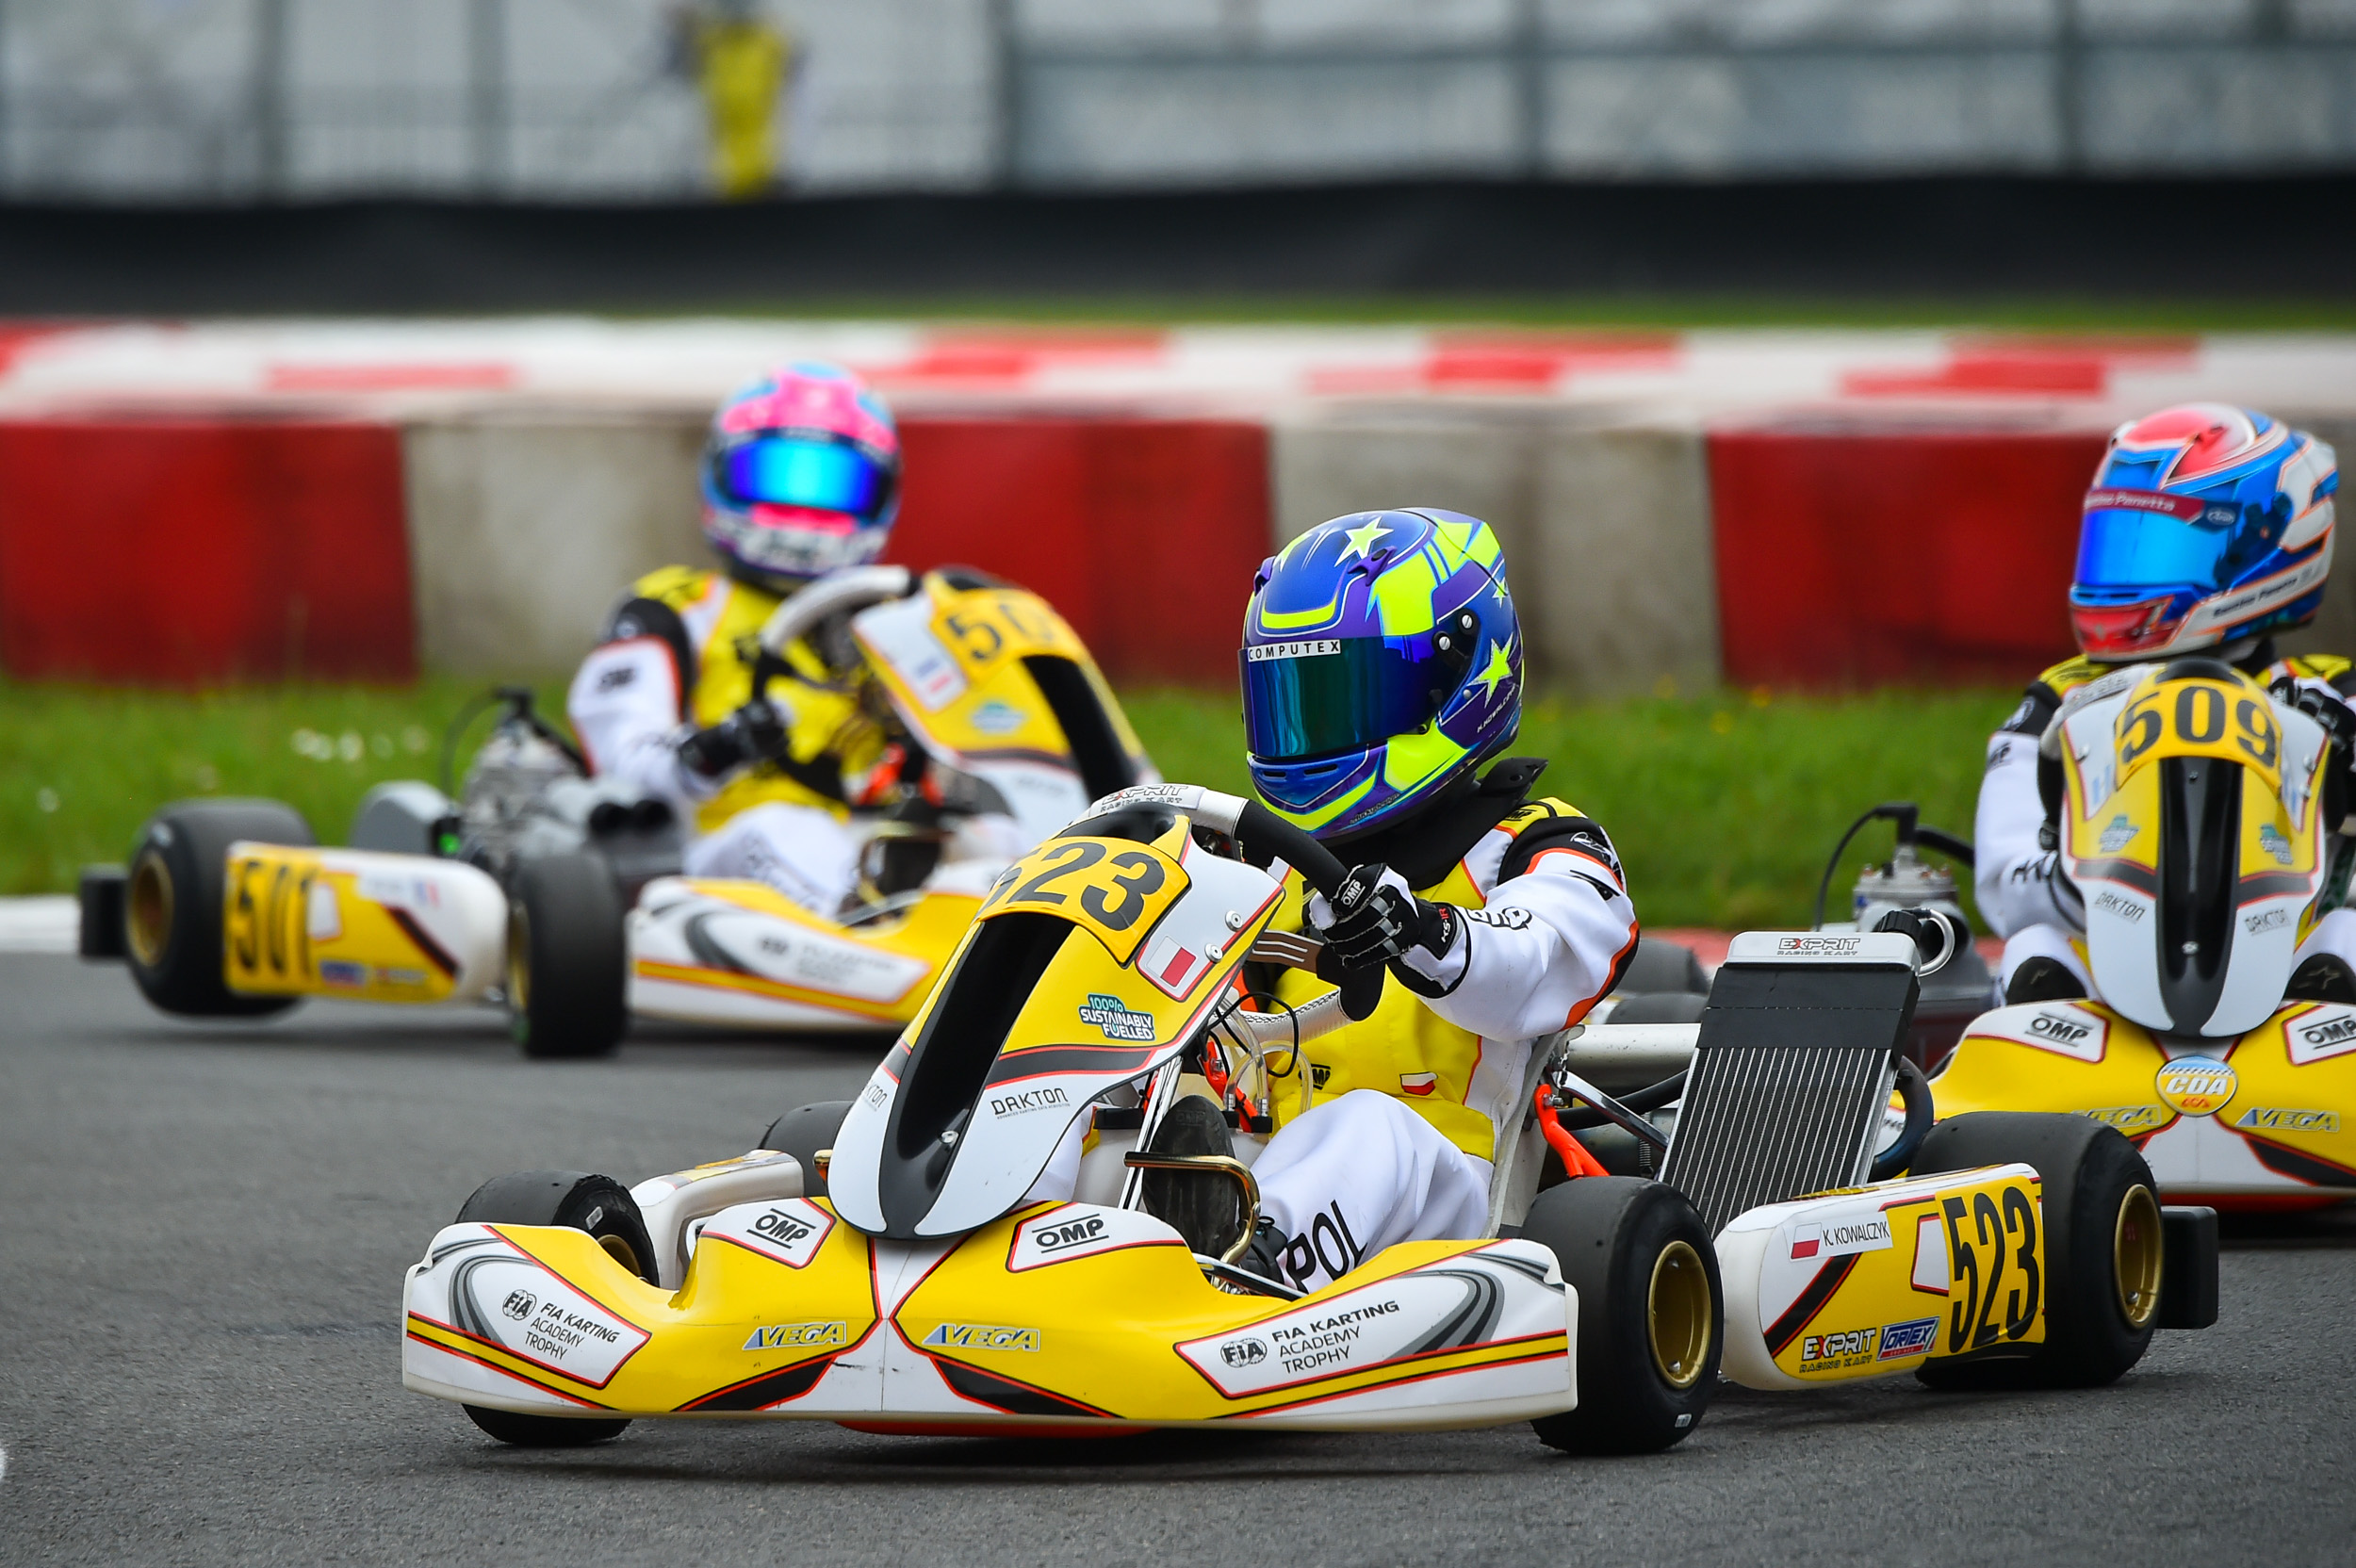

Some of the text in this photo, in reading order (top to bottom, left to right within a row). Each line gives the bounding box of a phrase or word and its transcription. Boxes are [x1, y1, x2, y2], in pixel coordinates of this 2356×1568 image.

[1249, 641, 1339, 660] COMPUTEX
[2122, 686, 2277, 769] 509
[1102, 785, 1188, 806] EXPRIT
[975, 841, 1166, 932] 523
[1342, 880, 1363, 906] OMP
[1778, 938, 1861, 951] EXPRIT
[1089, 996, 1124, 1013] 100%
[1080, 1008, 1152, 1029] SUSTAINABLY
[1102, 1022, 1153, 1040] FUELLED
[2031, 1017, 2089, 1042] OMP
[2304, 1020, 2356, 1044] OMP
[2166, 1075, 2228, 1096] CDA
[990, 1087, 1069, 1116] DAKTON
[2255, 1109, 2339, 1132] VEGA
[755, 1214, 810, 1242] OMP
[1036, 1218, 1104, 1248] OMP
[1833, 1221, 1890, 1245] KOWALCZYK
[1285, 1199, 1368, 1295] POL
[1941, 1185, 2040, 1353] 523
[530, 1316, 584, 1348] ACADEMY
[540, 1302, 564, 1320] FIA
[564, 1314, 620, 1343] KARTING
[1271, 1327, 1306, 1343] FIA
[1309, 1300, 1400, 1333] KARTING
[525, 1331, 567, 1360] TROPHY
[758, 1323, 845, 1348] VEGA
[943, 1325, 1038, 1349] VEGA
[1279, 1326, 1360, 1358] ACADEMY
[1802, 1328, 1876, 1361] EXPRIT
[1878, 1325, 1934, 1354] VORTEX
[1282, 1345, 1350, 1374] TROPHY
[1799, 1355, 1873, 1374] RACING KART
